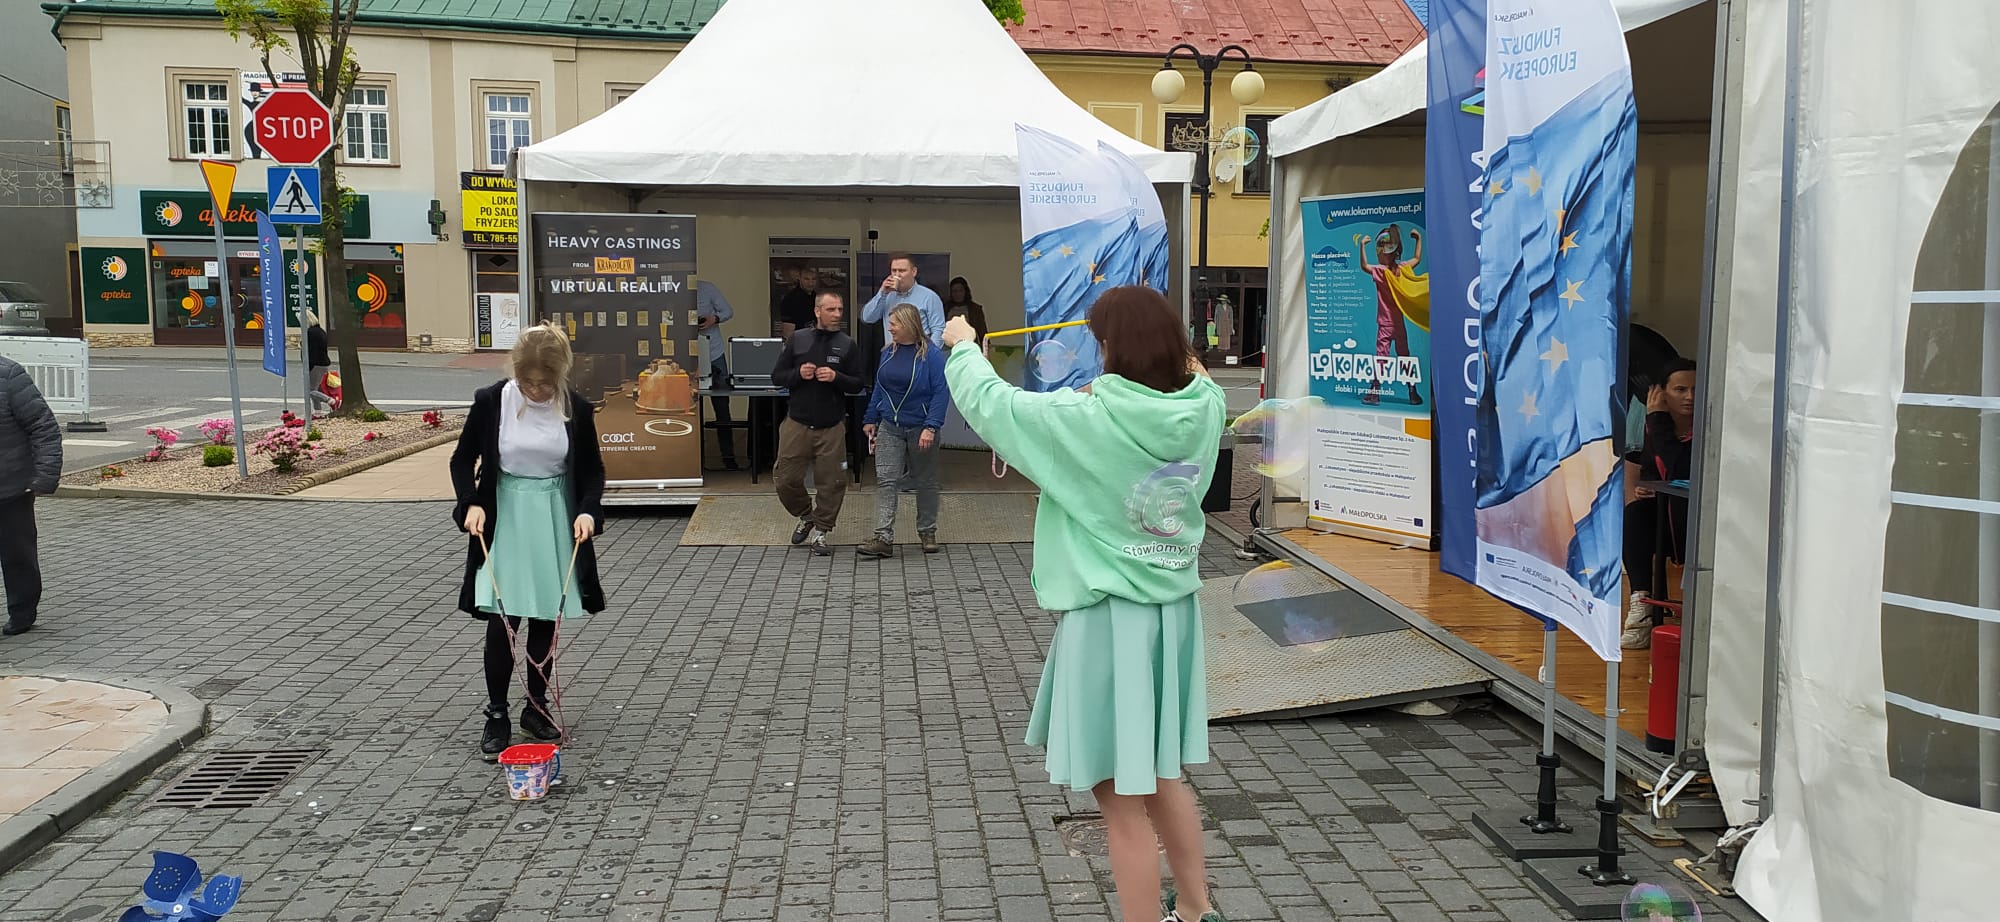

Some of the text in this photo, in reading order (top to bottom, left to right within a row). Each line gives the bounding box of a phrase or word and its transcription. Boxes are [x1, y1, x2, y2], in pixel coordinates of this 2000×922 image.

[262, 116, 324, 140] STOP
[471, 176, 484, 187] DO
[480, 206, 492, 216] PO
[1330, 202, 1422, 217] www.lokomotywa.net.pl
[472, 233, 518, 243] TEL. 785-55
[548, 236, 682, 250] HEAVY CASTINGS
[170, 266, 201, 278] apteka
[550, 280, 681, 293] VIRTUAL REALITY
[100, 289, 131, 301] apteka
[479, 296, 491, 332] SOLARIUM
[1313, 354, 1419, 379] LOKOMOTYWA
[1334, 384, 1353, 393] żłobki
[1357, 386, 1395, 396] przedszkola
[1348, 509, 1388, 521] MAŁOPOLSKA
